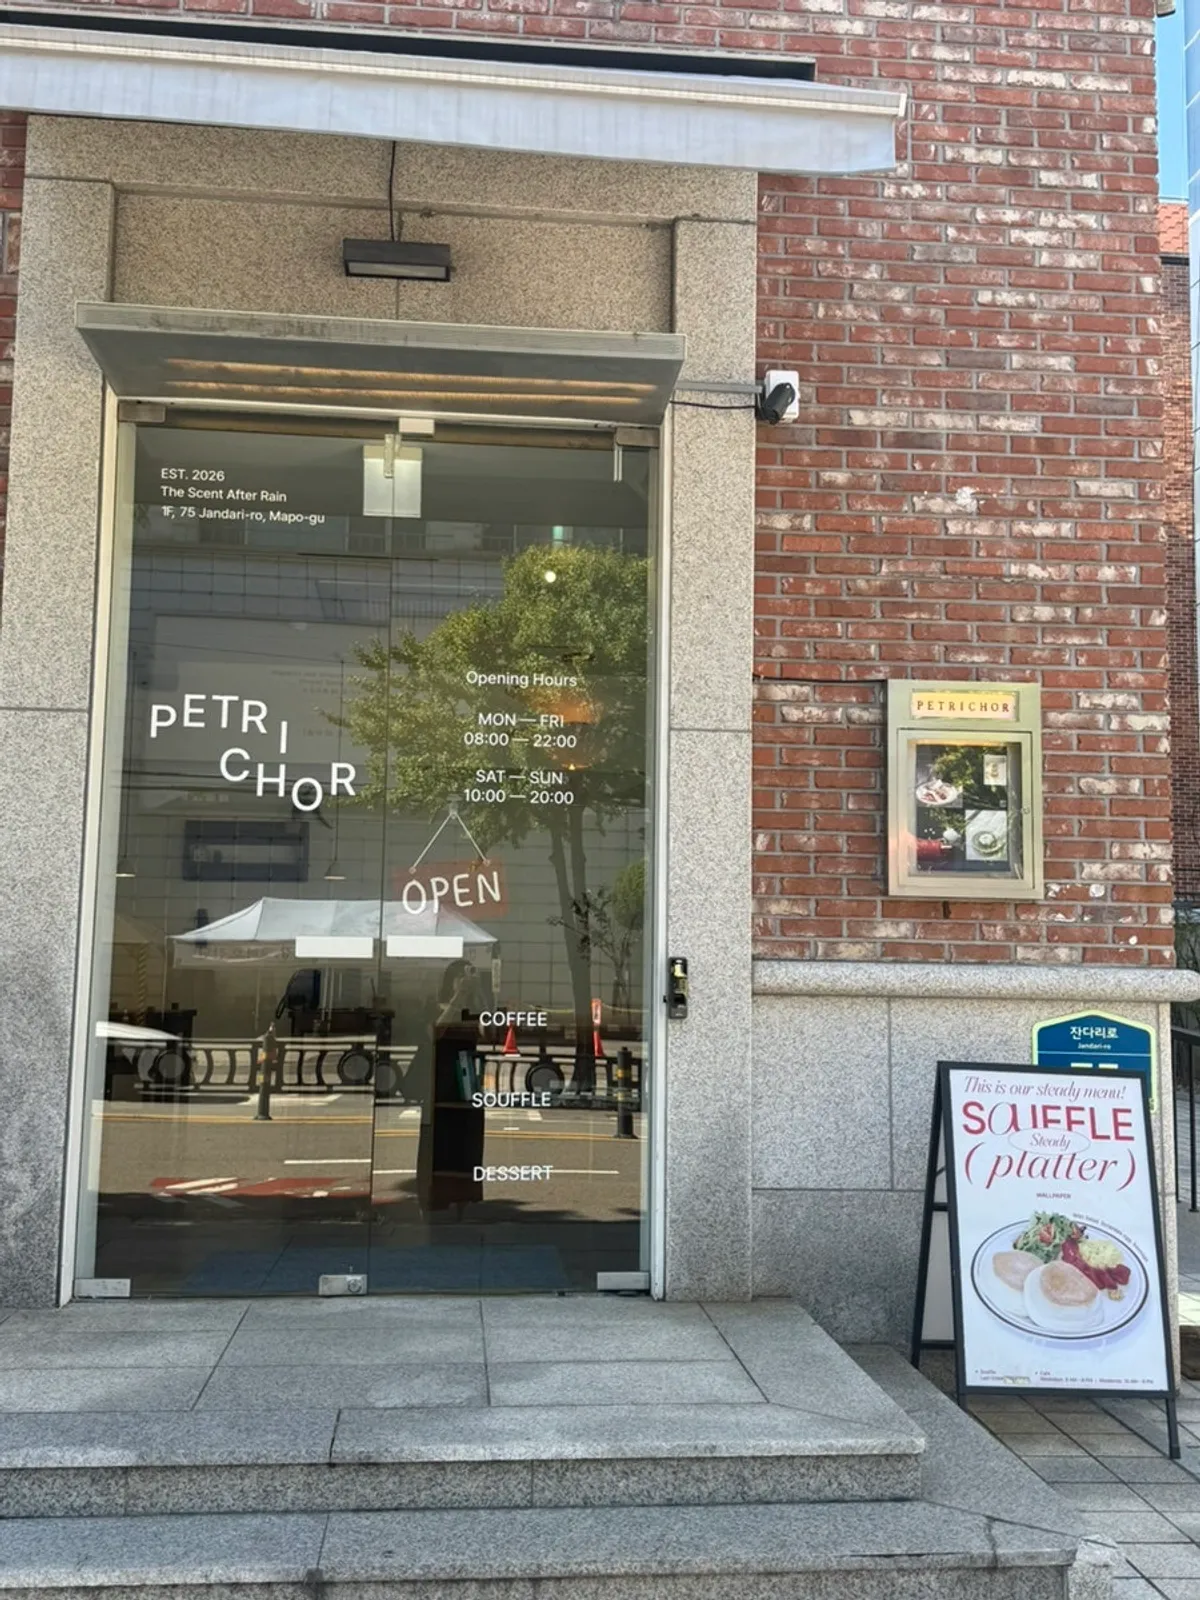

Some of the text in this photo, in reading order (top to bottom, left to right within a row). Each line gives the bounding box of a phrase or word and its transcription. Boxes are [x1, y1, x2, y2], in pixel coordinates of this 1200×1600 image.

[160, 467, 226, 482] EST. 2026
[160, 485, 287, 502] The Scent After Rain
[161, 505, 325, 526] 1F, 75 Jandari-ro, Mapo-gu
[466, 670, 578, 689] Opening Hours
[916, 700, 1010, 713] PETRICHOR
[463, 731, 510, 747] 08:00
[532, 733, 577, 748] 22:00
[463, 788, 506, 803] 10:00
[529, 790, 575, 804] 20:00
[402, 871, 501, 915] OPEN
[479, 1011, 548, 1027] COFFEE
[1069, 1026, 1119, 1040] 잔다리로
[963, 1075, 1127, 1102] This is our steady menu!
[472, 1091, 552, 1108] SOUFFLE
[1029, 1133, 1072, 1151] Steady
[473, 1164, 553, 1182] DESSERT
